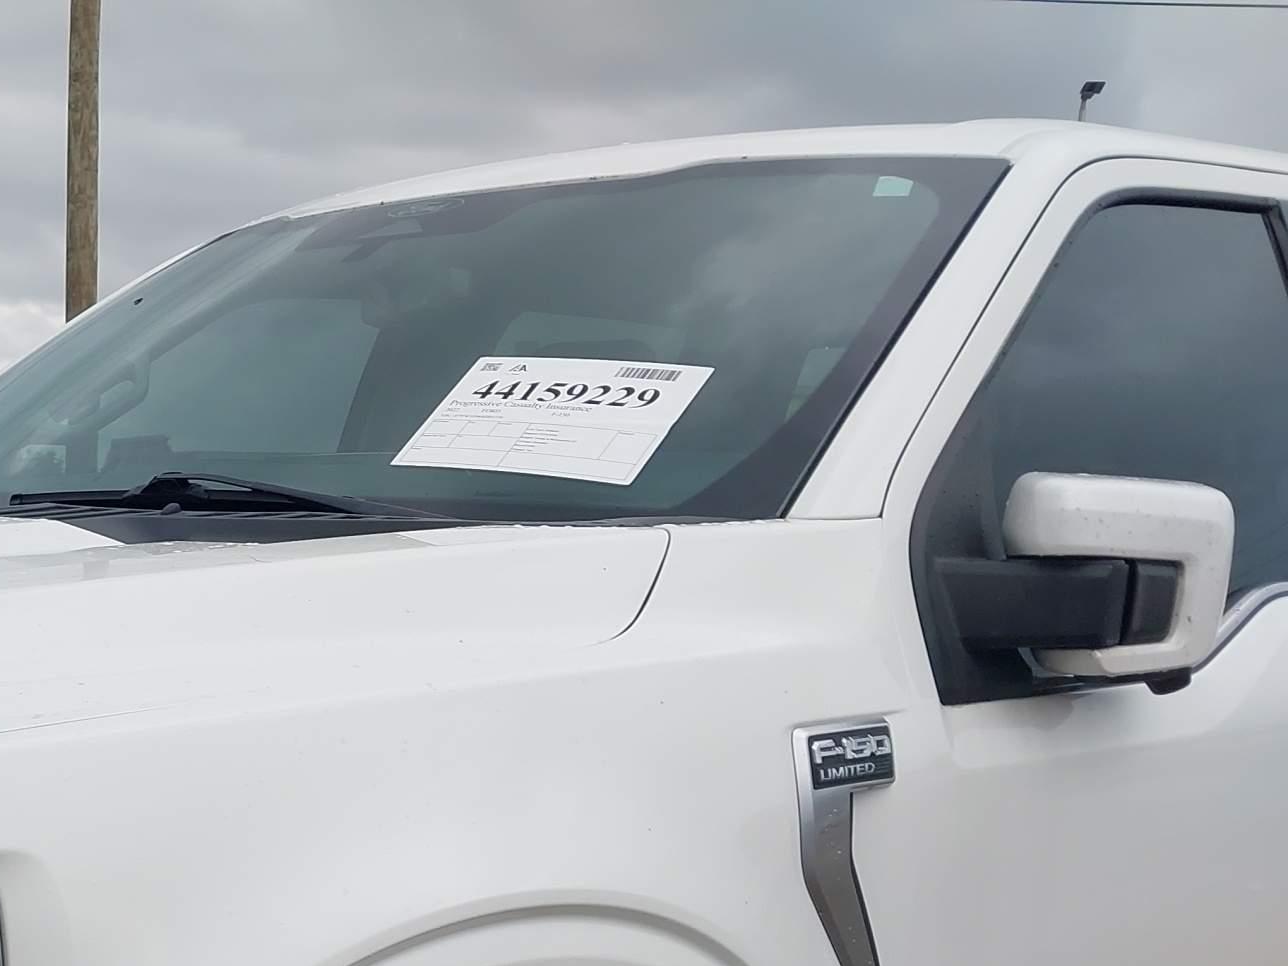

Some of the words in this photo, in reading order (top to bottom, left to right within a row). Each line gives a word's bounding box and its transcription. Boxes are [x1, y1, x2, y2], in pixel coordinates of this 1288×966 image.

[449, 399, 503, 409] Progressive
[504, 400, 543, 410] Casualty
[545, 402, 593, 412] Insurance
[472, 380, 662, 409] 44159229
[811, 734, 892, 764] F-150
[819, 762, 876, 781] LIMITED
